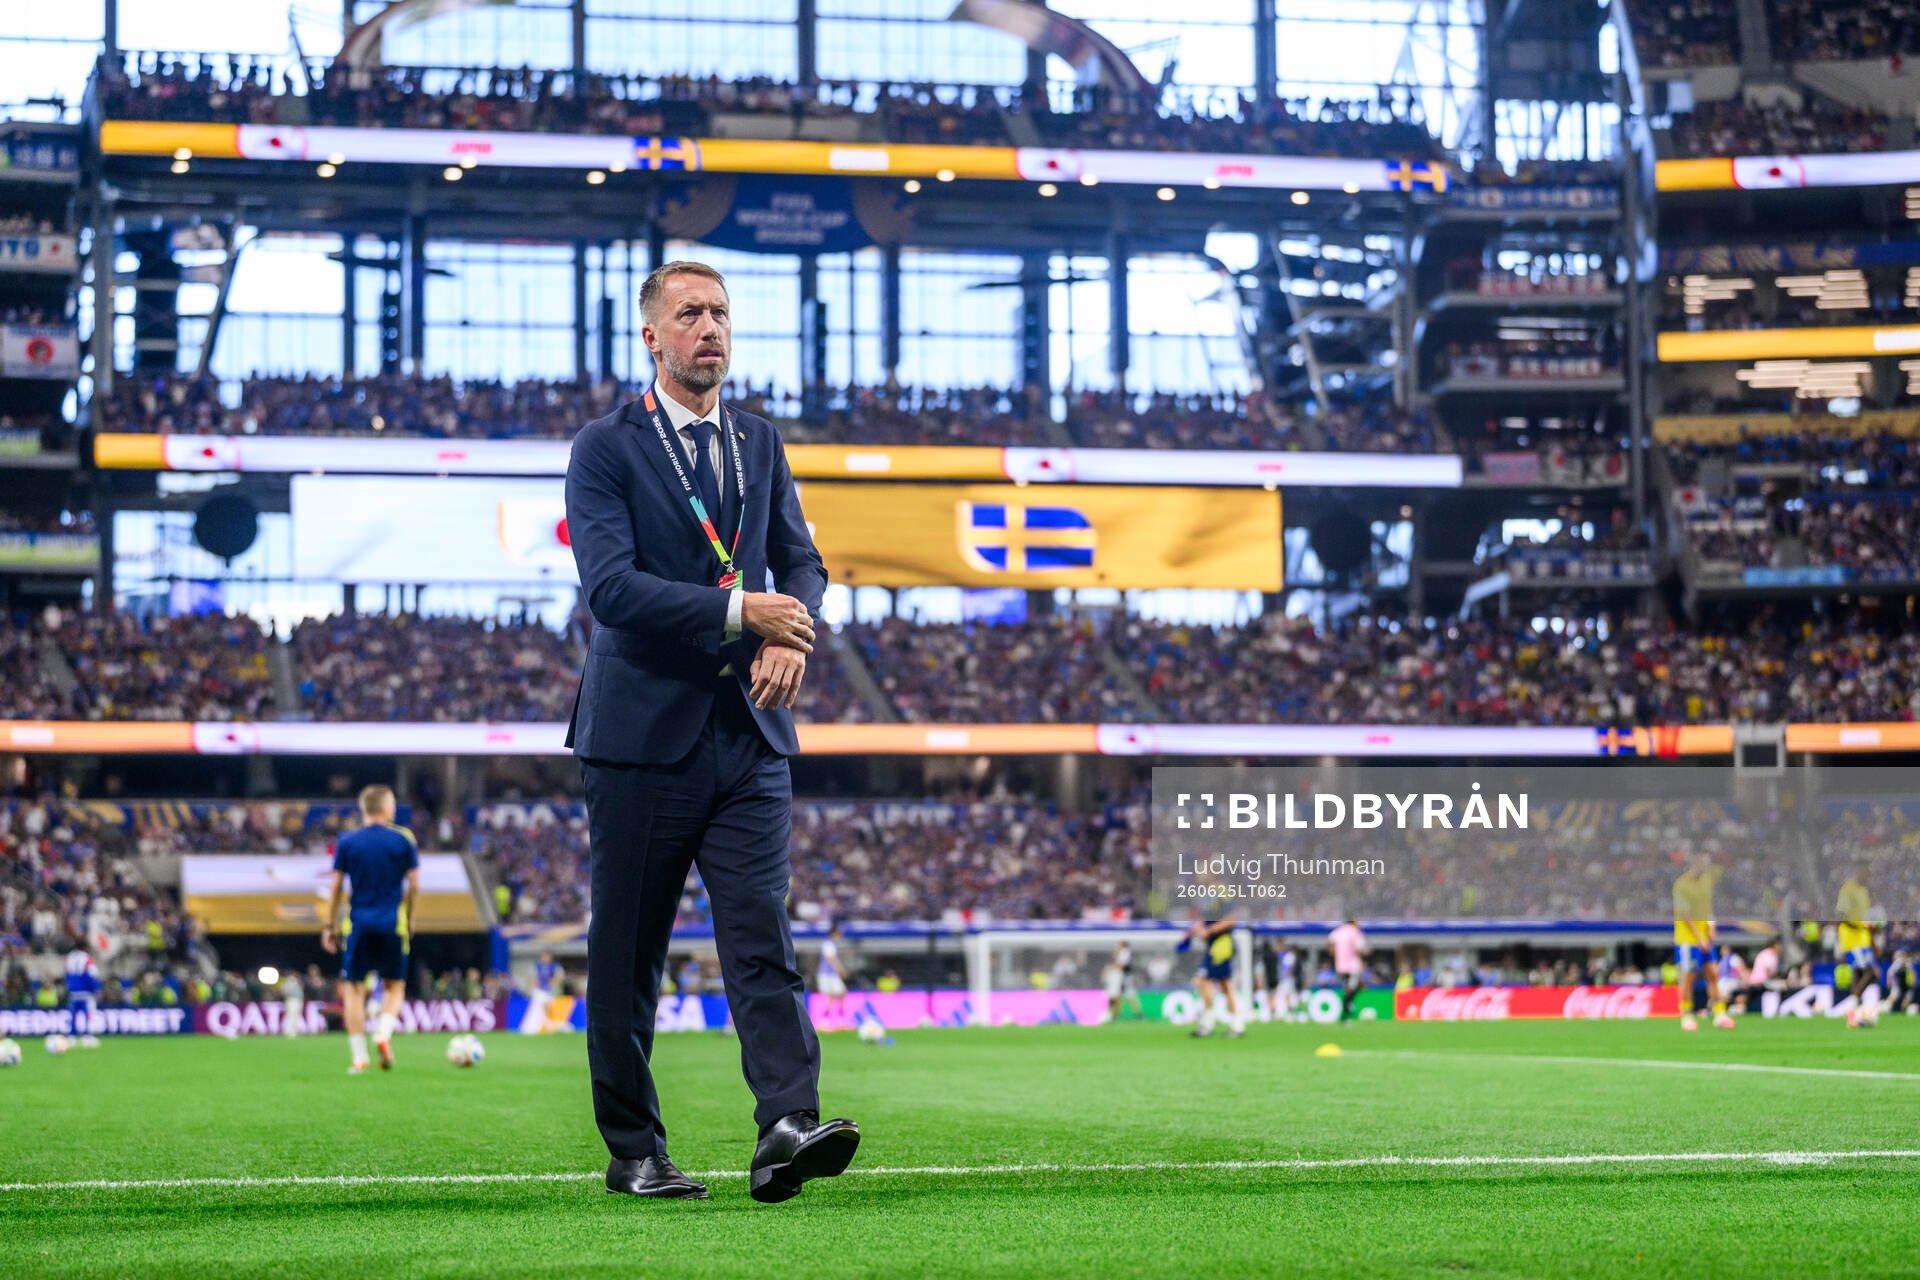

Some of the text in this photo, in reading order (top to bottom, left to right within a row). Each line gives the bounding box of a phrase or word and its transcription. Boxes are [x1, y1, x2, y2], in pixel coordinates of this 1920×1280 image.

[652, 415, 692, 491] FIFA WORLD CUP 2026
[731, 434, 740, 458] WORLD
